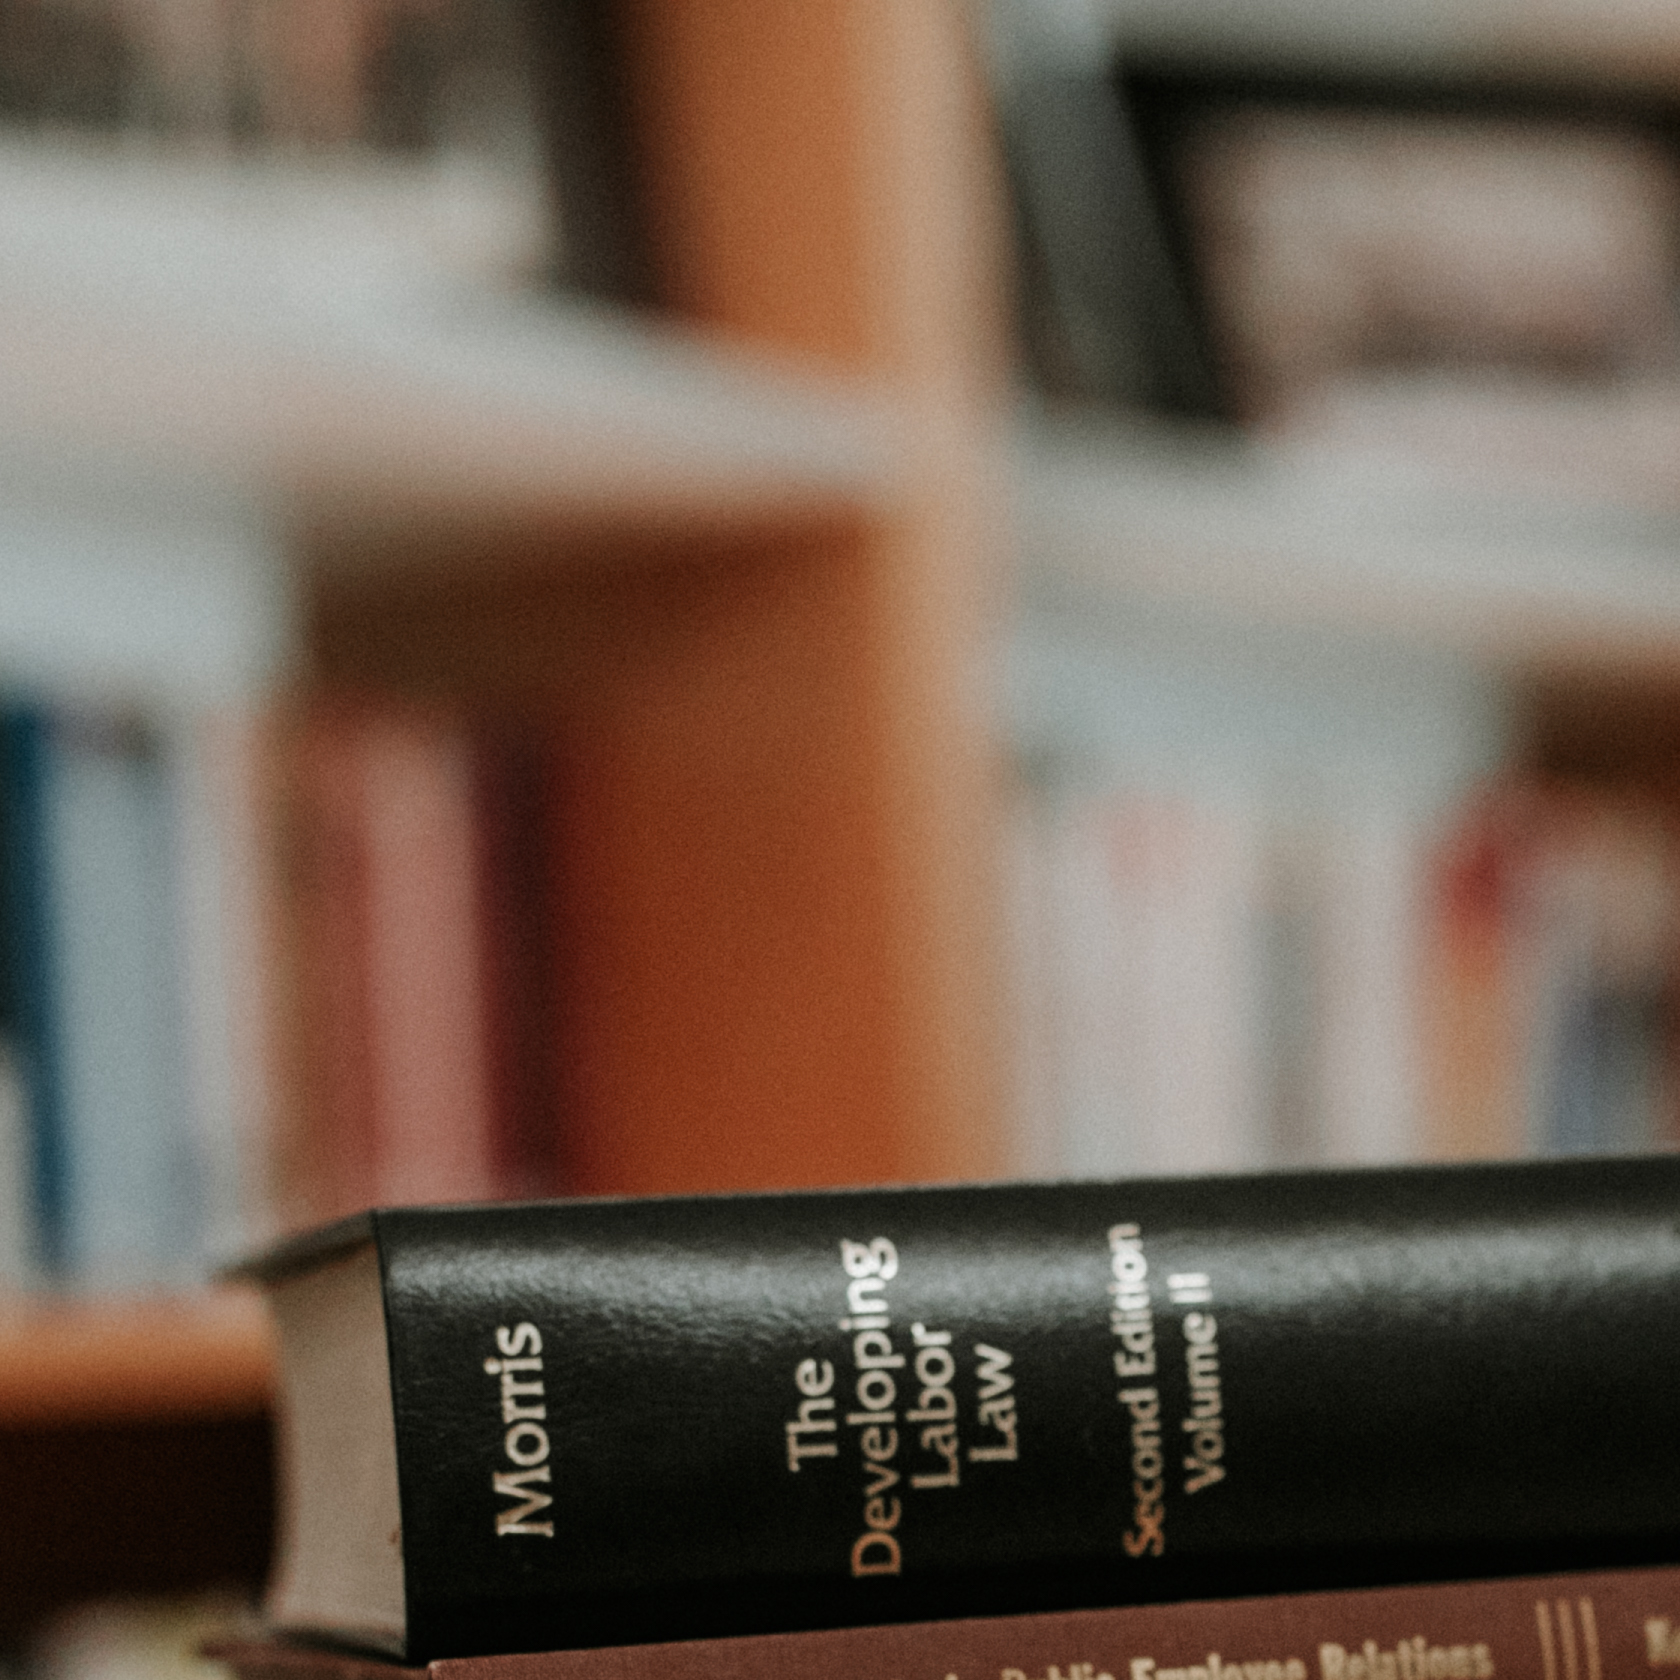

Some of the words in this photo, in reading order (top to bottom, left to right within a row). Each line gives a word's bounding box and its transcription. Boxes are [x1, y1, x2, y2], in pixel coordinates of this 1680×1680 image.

[1108, 1223, 1158, 1379] Edition
[482, 1321, 556, 1539] Morris
[784, 1357, 839, 1474] The
[839, 1236, 905, 1578] Developing
[908, 1322, 963, 1490] Labor
[969, 1342, 1019, 1463] Law
[1118, 1388, 1166, 1558] Second
[1181, 1308, 1226, 1494] Volume
